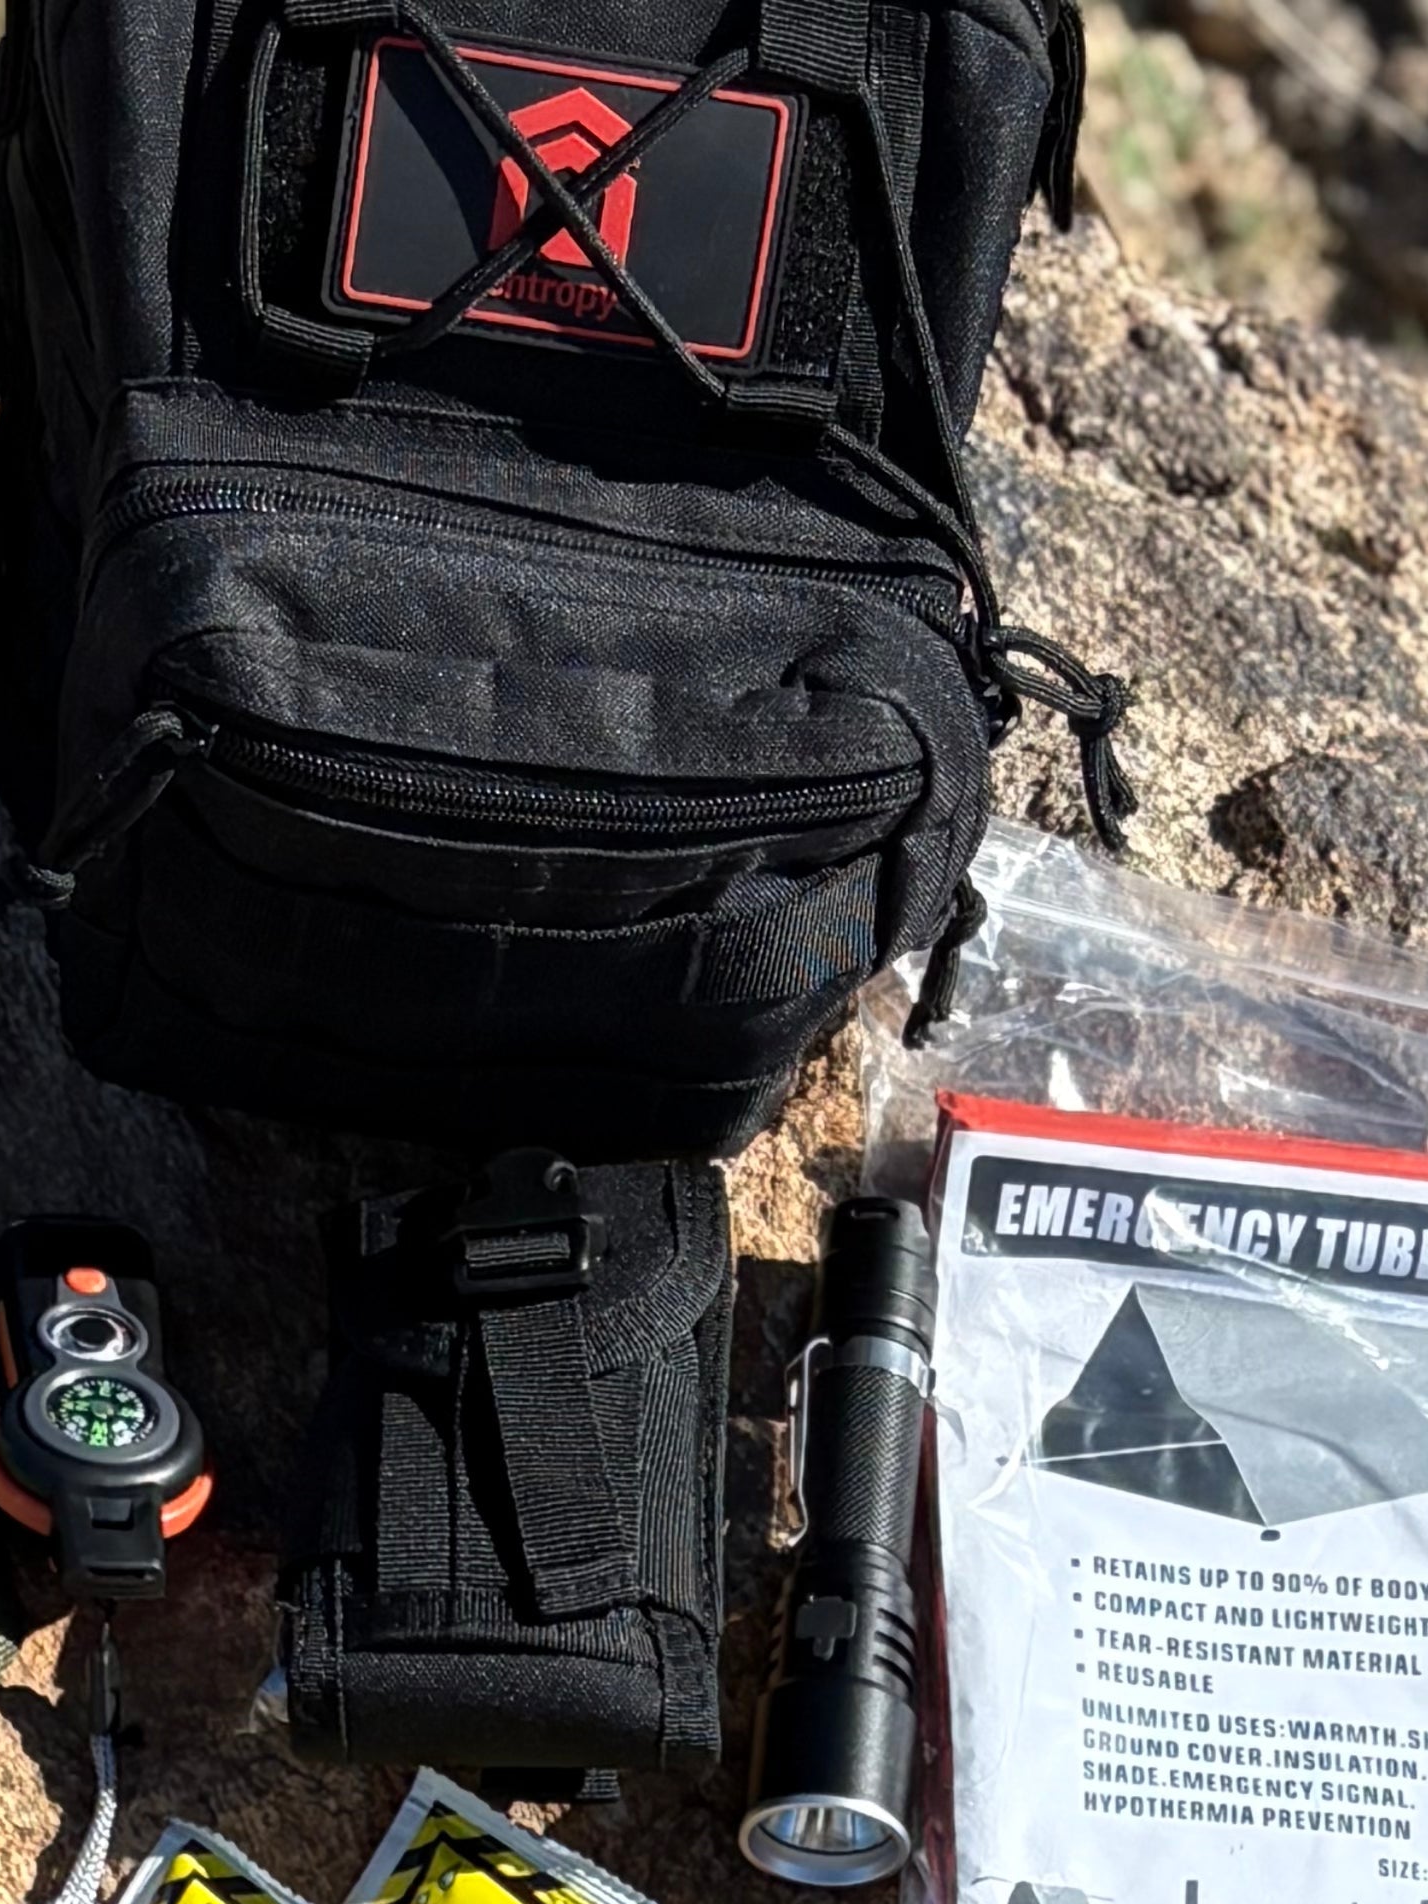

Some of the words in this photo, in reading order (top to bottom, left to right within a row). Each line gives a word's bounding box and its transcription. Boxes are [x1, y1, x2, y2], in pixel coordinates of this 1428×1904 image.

[995, 1183, 1308, 1268] EMERGENCY
[1093, 1555, 1191, 1585] RETAINS
[1199, 1567, 1229, 1589] UP
[1237, 1569, 1263, 1591] TO
[1271, 1572, 1328, 1594] 90%
[1335, 1575, 1362, 1597] OF
[1094, 1591, 1207, 1622] COMPACT
[1214, 1605, 1263, 1627] AND
[1095, 1627, 1295, 1667] TEAR-RESISTANT
[1302, 1648, 1422, 1676] MATERIAL
[1097, 1660, 1213, 1694] REUSABLE
[1082, 1697, 1210, 1732] UNLIMITED
[1083, 1728, 1179, 1758] GROUND
[1084, 1791, 1254, 1825] HYPOTHERMIA
[1262, 1807, 1410, 1840] PREVENTION
